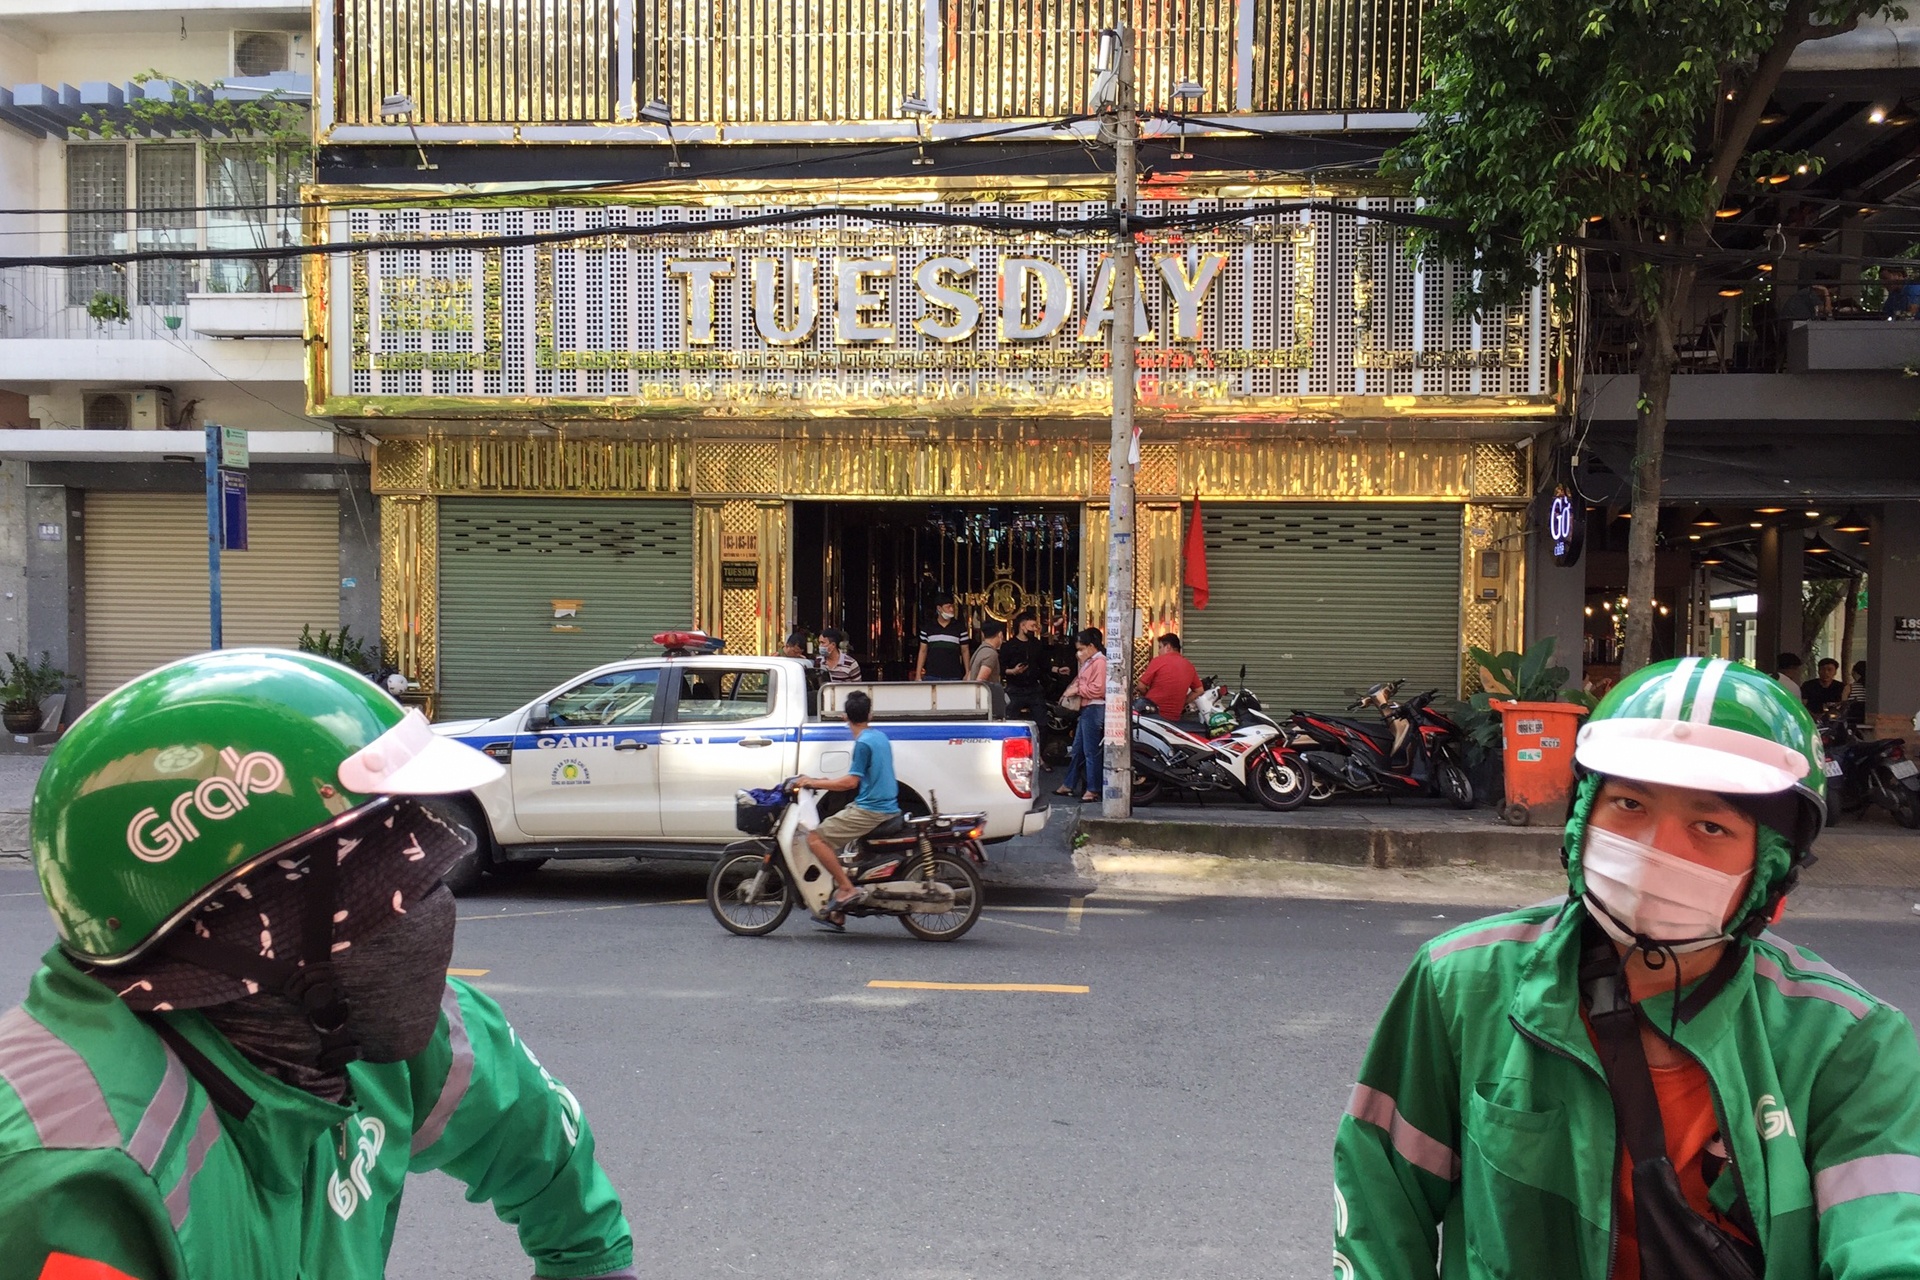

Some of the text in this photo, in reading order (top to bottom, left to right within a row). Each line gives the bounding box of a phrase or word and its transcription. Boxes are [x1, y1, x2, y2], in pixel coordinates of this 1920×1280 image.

[666, 255, 1228, 344] TUESDAY
[41, 525, 59, 535] 181
[1550, 496, 1571, 540] Gờ
[723, 567, 757, 577] TUESDAY
[536, 733, 615, 749] CẢNH
[126, 745, 285, 863] Grab
